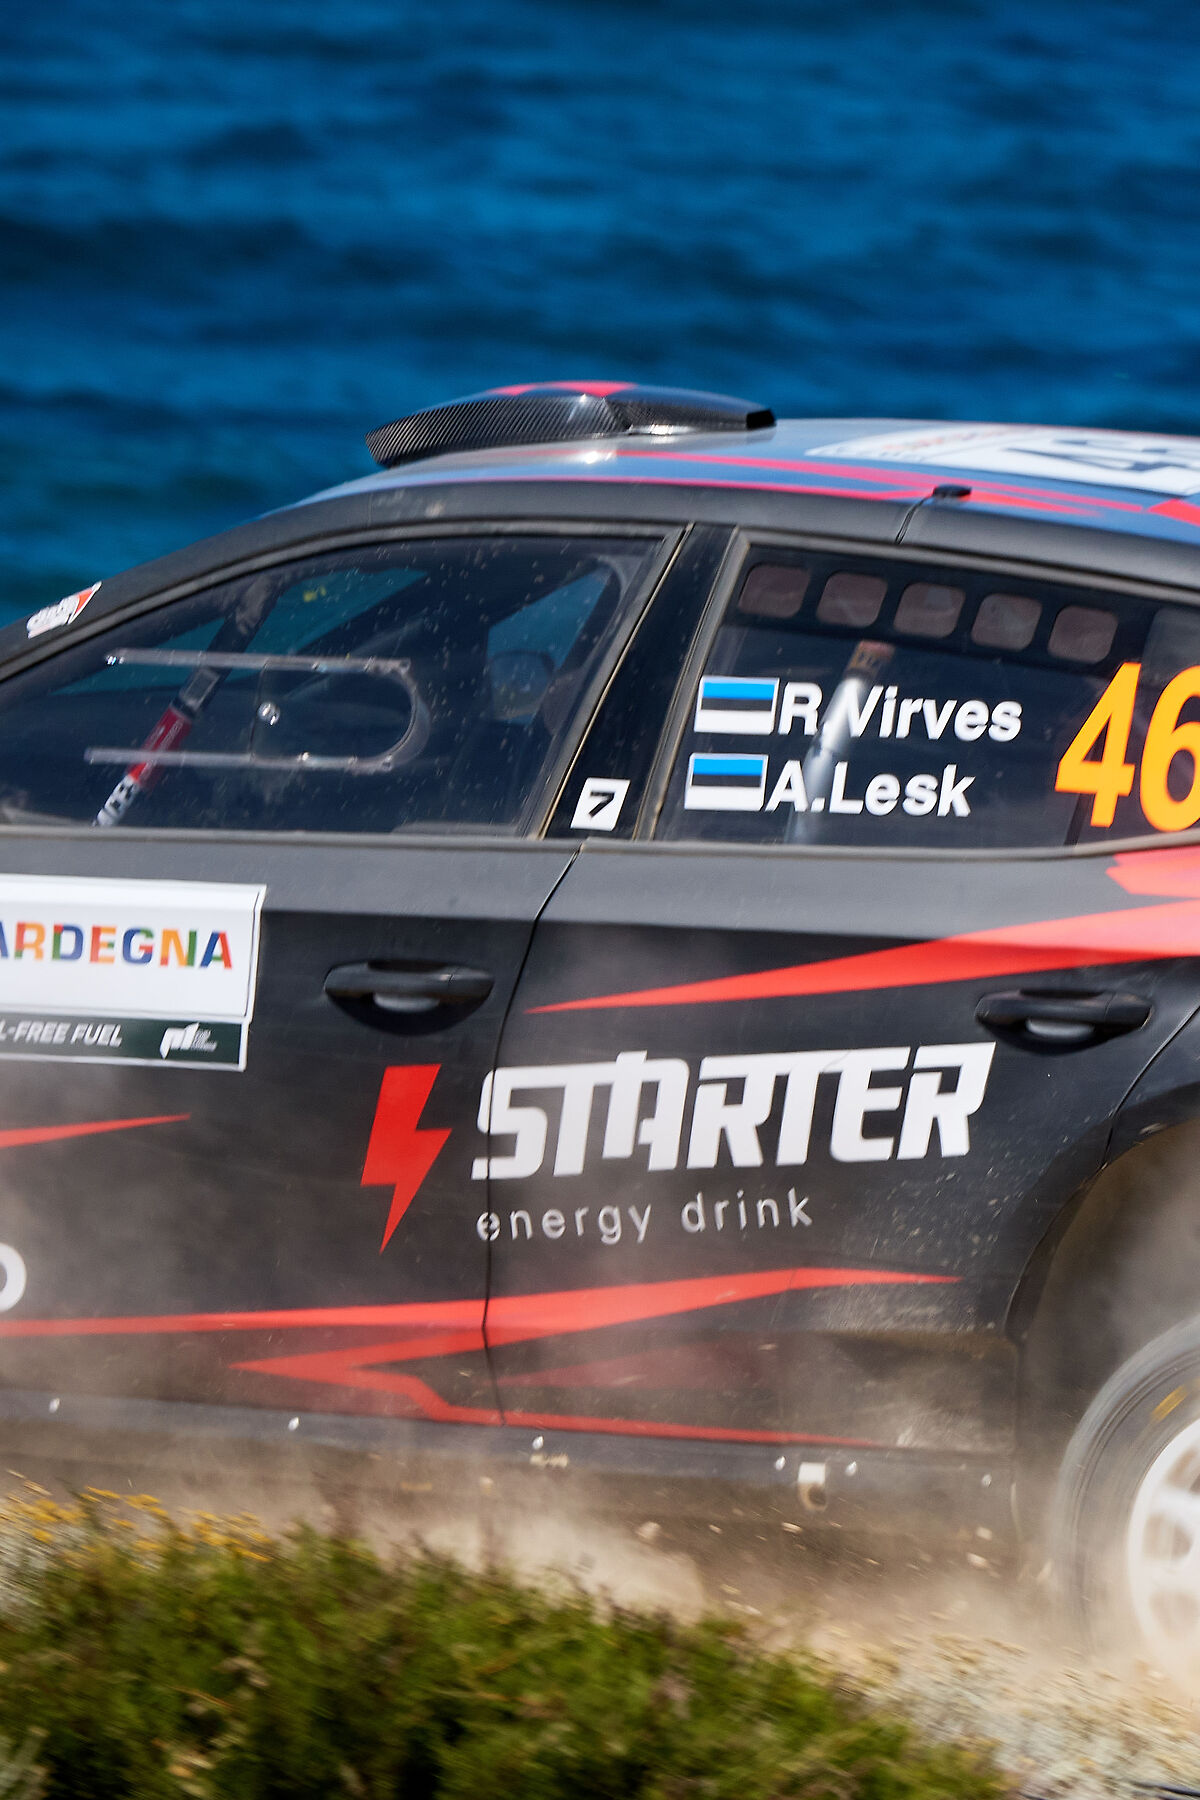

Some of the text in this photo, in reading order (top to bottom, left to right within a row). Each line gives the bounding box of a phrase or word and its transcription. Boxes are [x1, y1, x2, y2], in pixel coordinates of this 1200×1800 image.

[764, 760, 976, 817] A.Lesk
[0, 921, 232, 970] RDEGNA
[70, 1023, 122, 1047] FUEL
[471, 1042, 997, 1181] STARTER
[476, 1188, 813, 1245] energy drink
